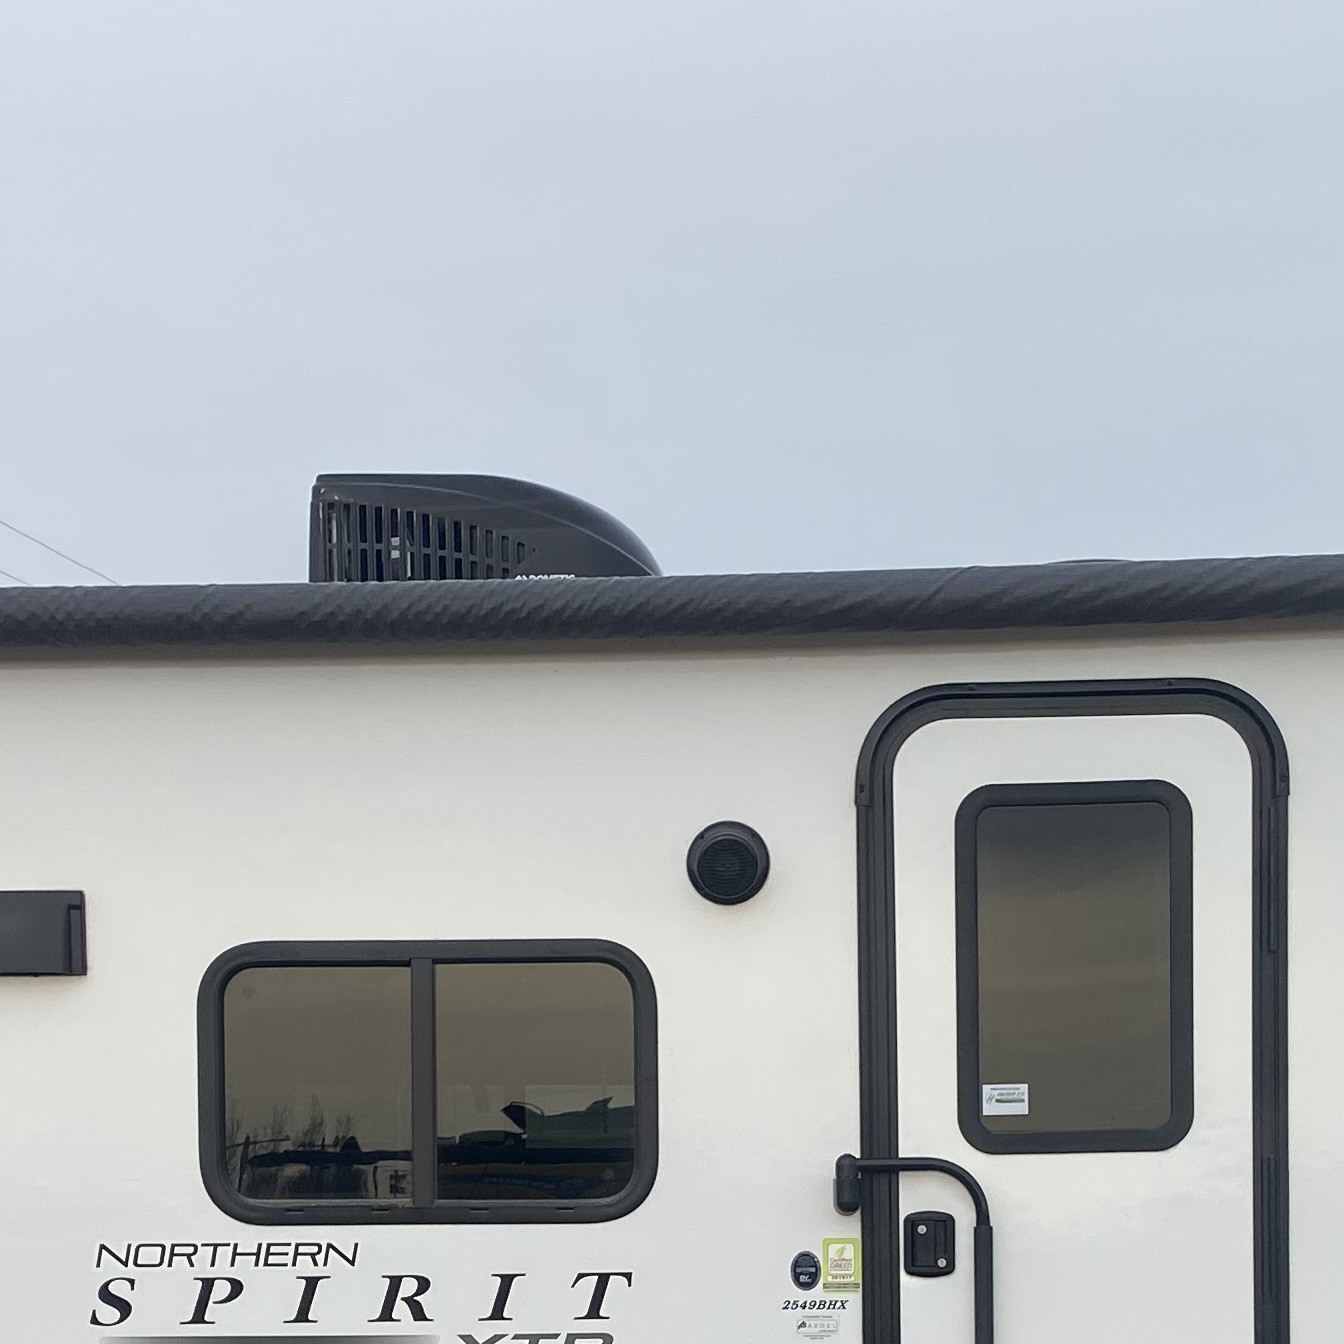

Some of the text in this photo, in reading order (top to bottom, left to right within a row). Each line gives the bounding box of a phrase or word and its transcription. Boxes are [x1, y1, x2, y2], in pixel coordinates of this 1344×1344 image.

[95, 1242, 359, 1268] NORTHERN
[89, 1272, 633, 1327] SPIRIT
[781, 1299, 850, 1311] 2549BHX
